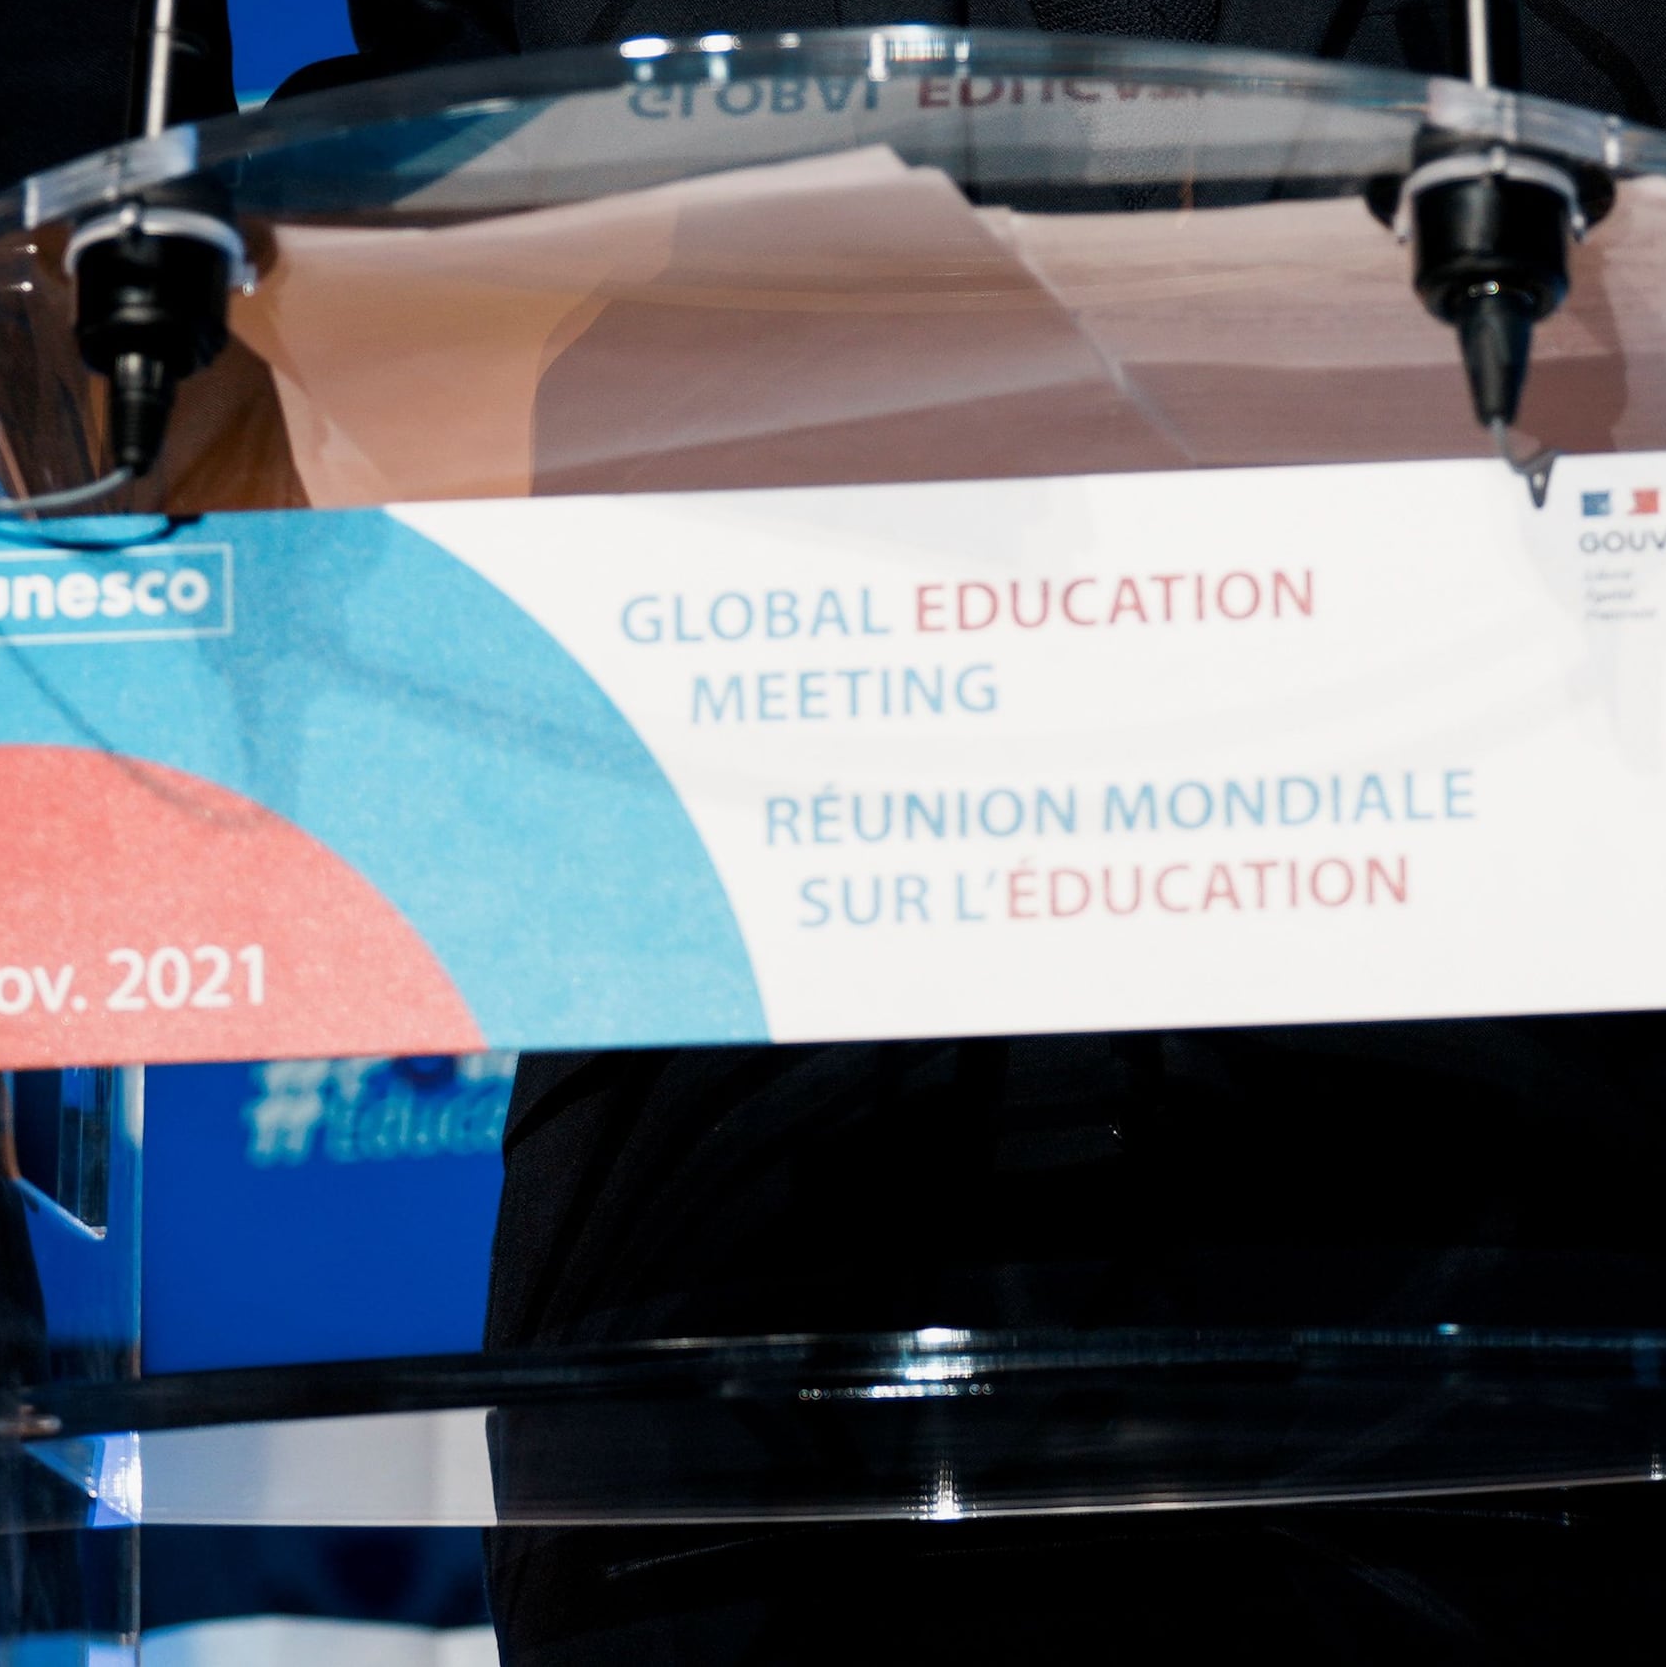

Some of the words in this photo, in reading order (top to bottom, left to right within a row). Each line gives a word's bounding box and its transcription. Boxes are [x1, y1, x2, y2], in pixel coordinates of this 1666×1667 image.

[619, 586, 892, 644] GLOBAL
[914, 569, 1315, 633] EDUCATION
[690, 664, 1000, 725] MEETING
[765, 781, 1077, 847] RÉUNION
[1103, 768, 1476, 833] MONDIALE
[798, 873, 931, 928] SUR
[955, 856, 1409, 923] L'ÉDUCATION
[106, 944, 266, 1009] 2021
